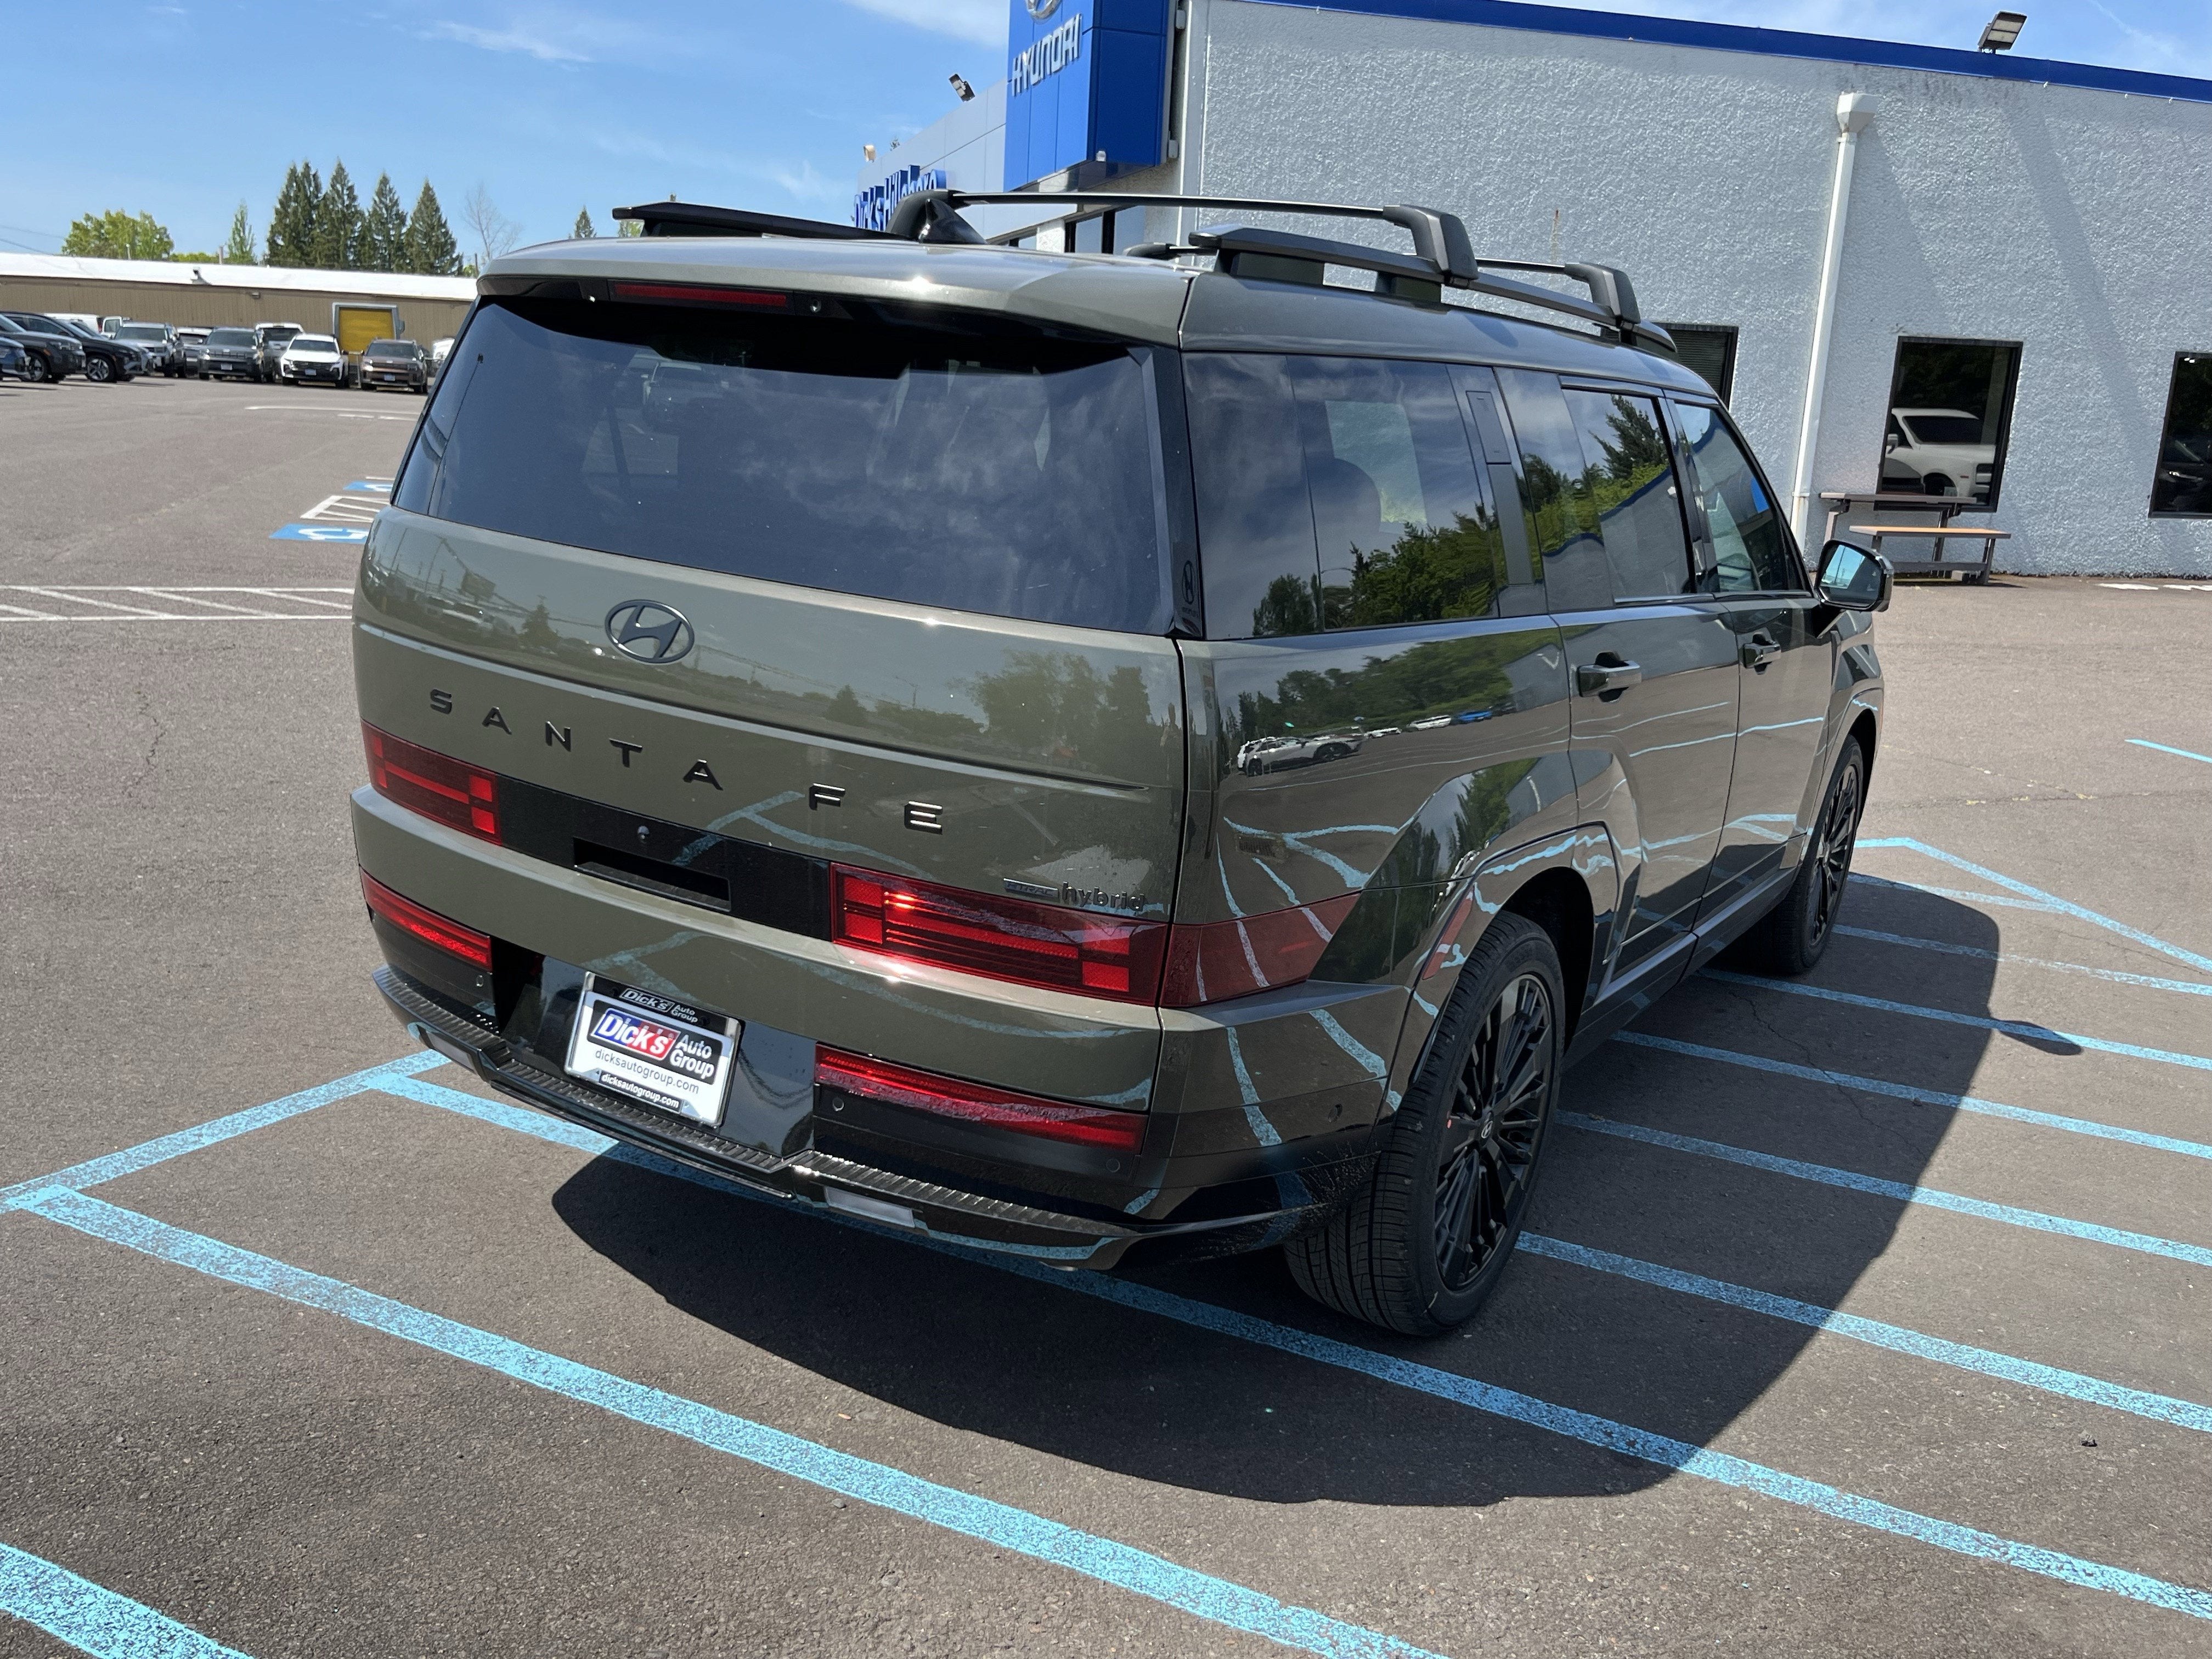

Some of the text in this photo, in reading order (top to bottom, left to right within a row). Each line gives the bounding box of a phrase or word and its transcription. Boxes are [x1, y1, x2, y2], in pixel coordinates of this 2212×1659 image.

[1012, 13, 1082, 97] HYUNDAI
[430, 689, 944, 835] SANTA FE
[1062, 881, 1146, 912] hybrid
[624, 990, 669, 1010] Dick's
[674, 1005, 696, 1015] Auto
[670, 1009, 698, 1023] Group
[598, 1013, 669, 1054] Dick's
[675, 1034, 713, 1059] Auto
[595, 1049, 699, 1094] dicksautogroup.com
[669, 1048, 715, 1079] Group
[601, 1073, 680, 1109] dicksautogroup.com
